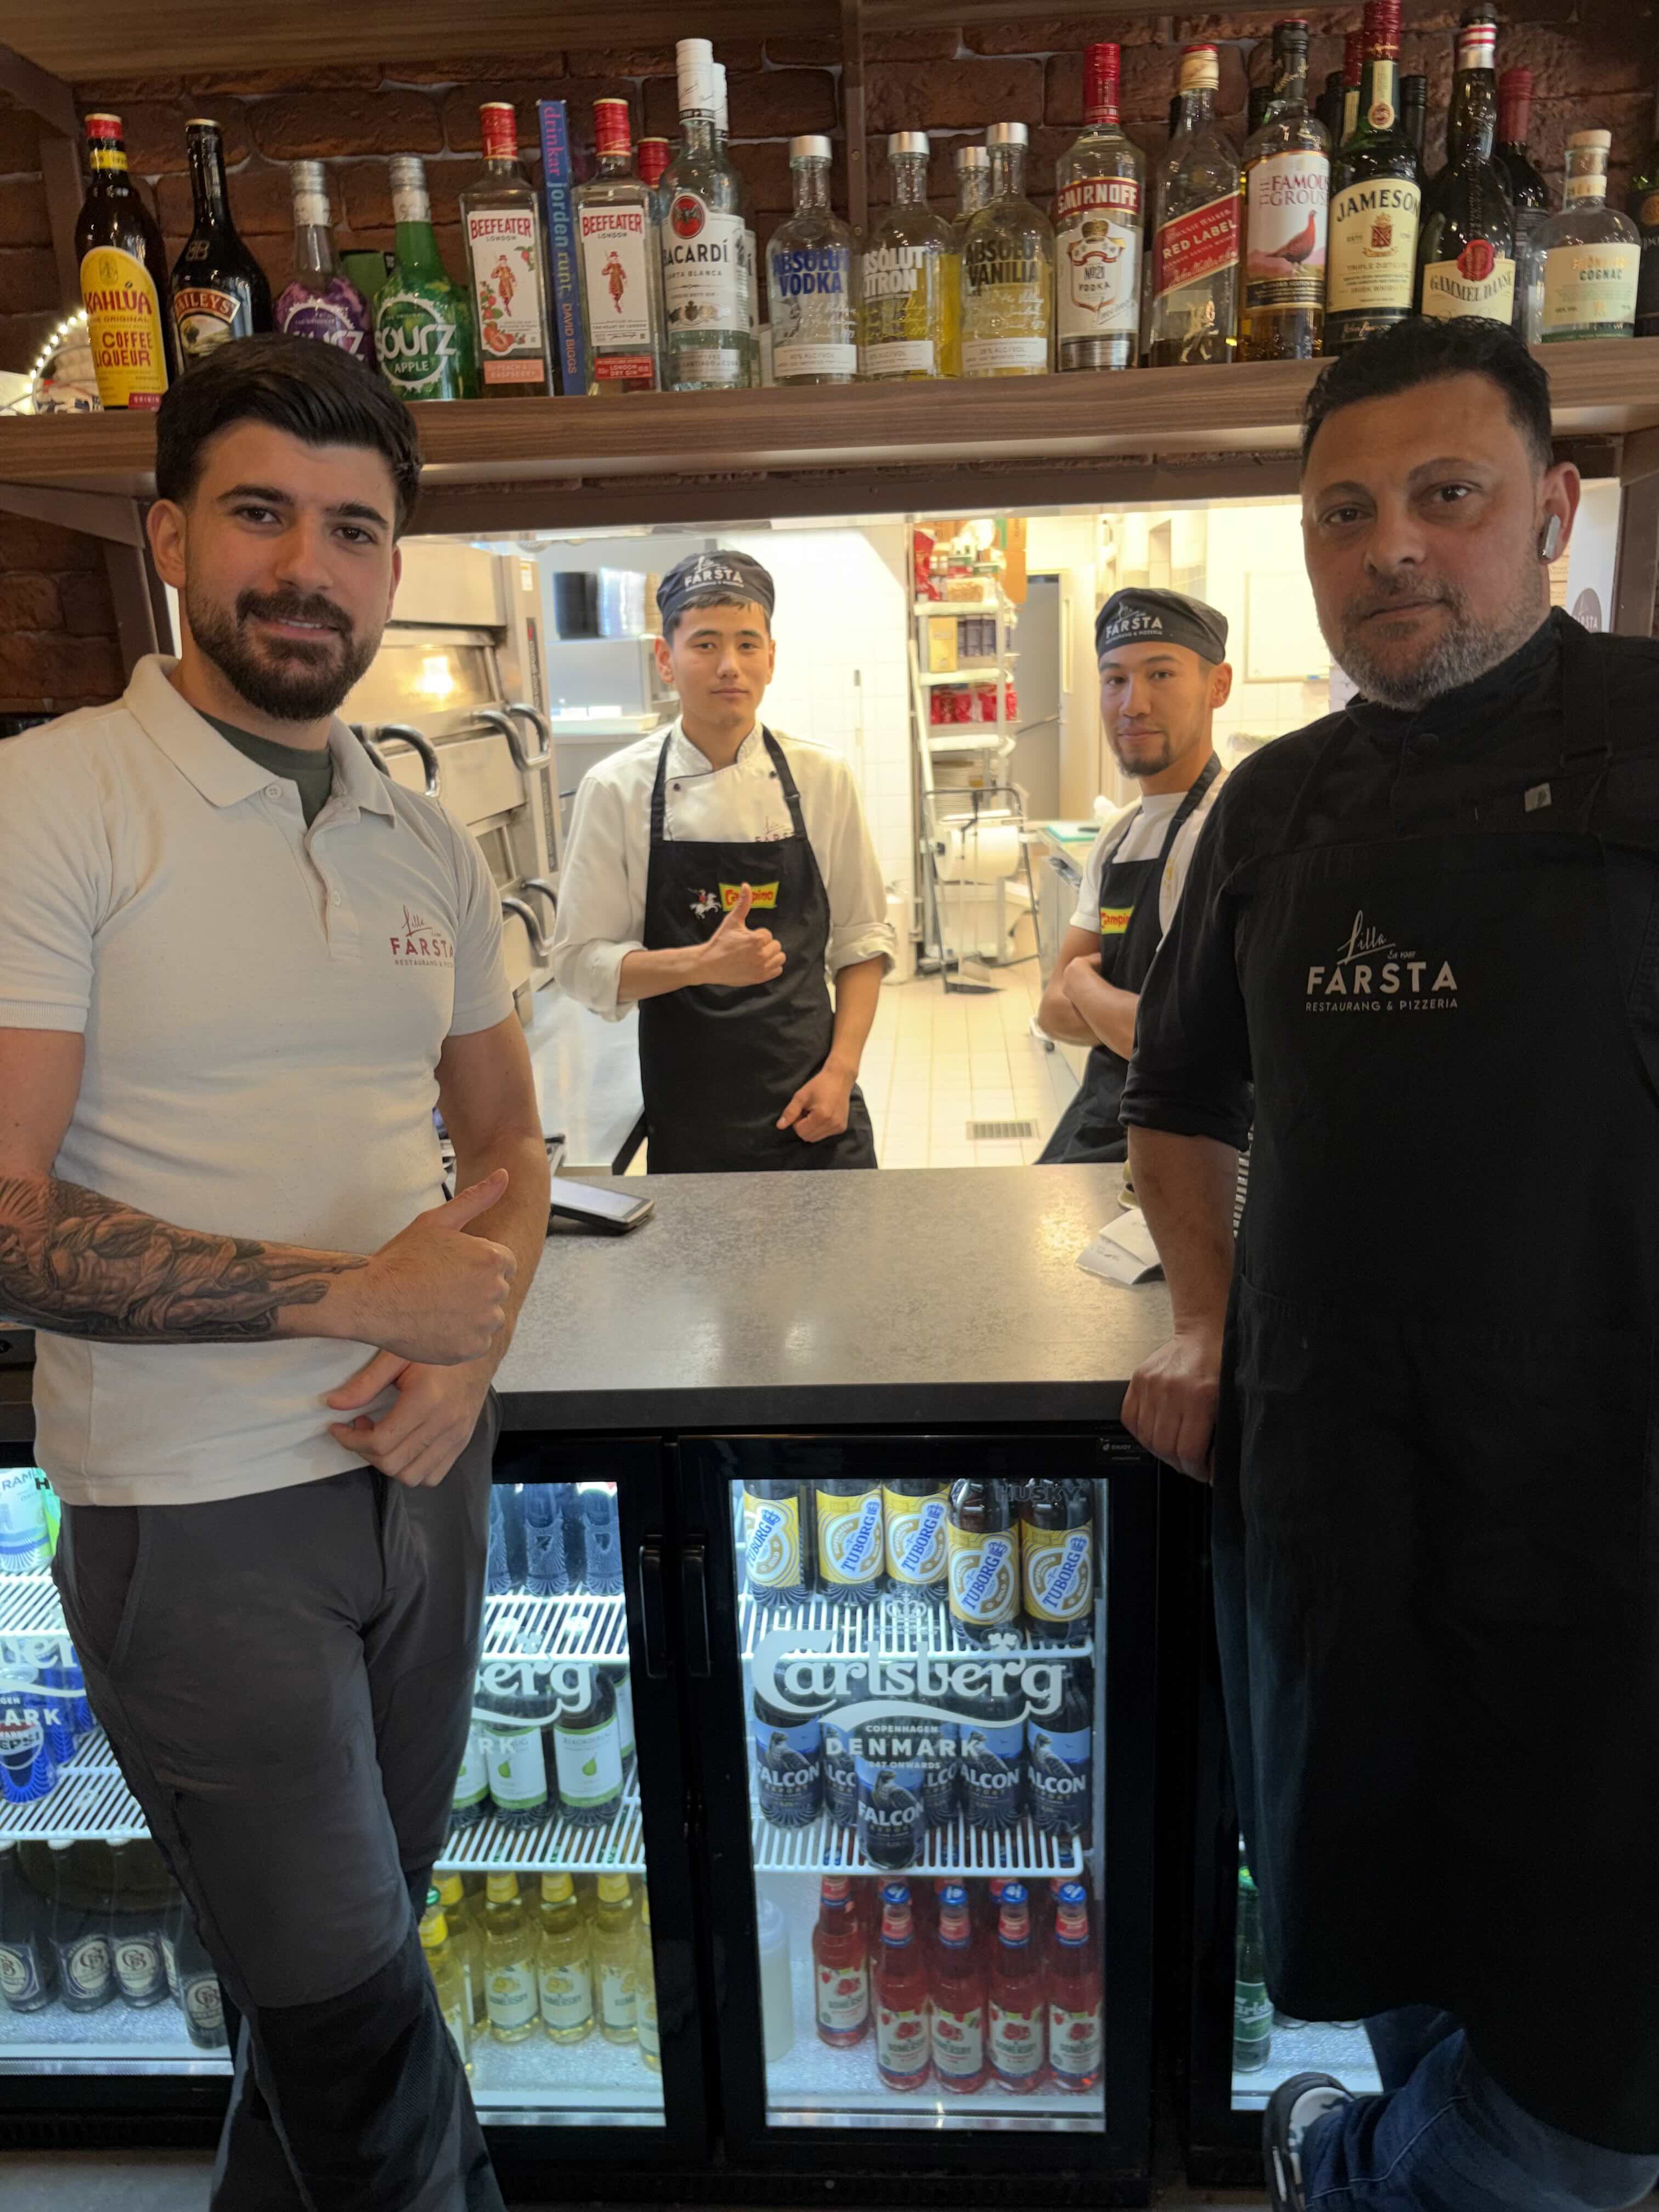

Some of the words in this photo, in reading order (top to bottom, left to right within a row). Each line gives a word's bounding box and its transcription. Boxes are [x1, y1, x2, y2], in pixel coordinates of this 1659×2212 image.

[544, 106, 561, 176] drinkar
[1269, 190, 1328, 206] GROUS
[1336, 189, 1421, 222] JAMESON
[546, 181, 568, 247] jorden
[582, 213, 642, 237] BEEFEATER
[470, 218, 532, 240] BEEFEATER
[1163, 239, 1191, 259] RED
[1193, 219, 1238, 245] LABEL
[556, 252, 572, 289] runt
[1579, 269, 1624, 281] COGNAC
[779, 273, 844, 297] VODKA
[1079, 282, 1110, 292] VODKA
[1429, 274, 1480, 302] GAMMEL
[177, 292, 230, 314] AILEYS
[562, 303, 573, 335] DAVID
[102, 331, 153, 349] COFFEE
[94, 351, 151, 368] LIQUEUR
[394, 360, 430, 374] APPLE
[565, 339, 577, 374] BIGGS
[684, 568, 744, 587] FARSTA
[1105, 616, 1163, 640] FARSTA
[390, 937, 454, 958] FARSTA
[1337, 910, 1396, 966] Lilla
[1306, 960, 1458, 995] FARSTA
[1305, 1001, 1381, 1012] RESTAURANG
[1386, 1001, 1393, 1011] &
[1400, 998, 1458, 1010] PIZZERIA
[996, 1485, 1082, 1502] HUSKY
[747, 1521, 772, 1567] TUBORG
[840, 1516, 875, 1572] TUBORG
[901, 1518, 937, 1572] TUBORG
[961, 1555, 1001, 1610] TUBORG
[1043, 1551, 1081, 1608] TUBORG
[751, 1629, 1066, 1717] Carlsberg
[0, 1731, 40, 1751] EPSI
[865, 1725, 939, 1733] COPENHAGEN
[826, 1738, 980, 1756] DENMARK
[758, 1760, 820, 1785] FALCON
[890, 1761, 941, 1769] ONWARDS
[961, 1762, 1019, 1789] ALCON
[1028, 1764, 1086, 1794] ALCON
[857, 1799, 924, 1826] FALCON
